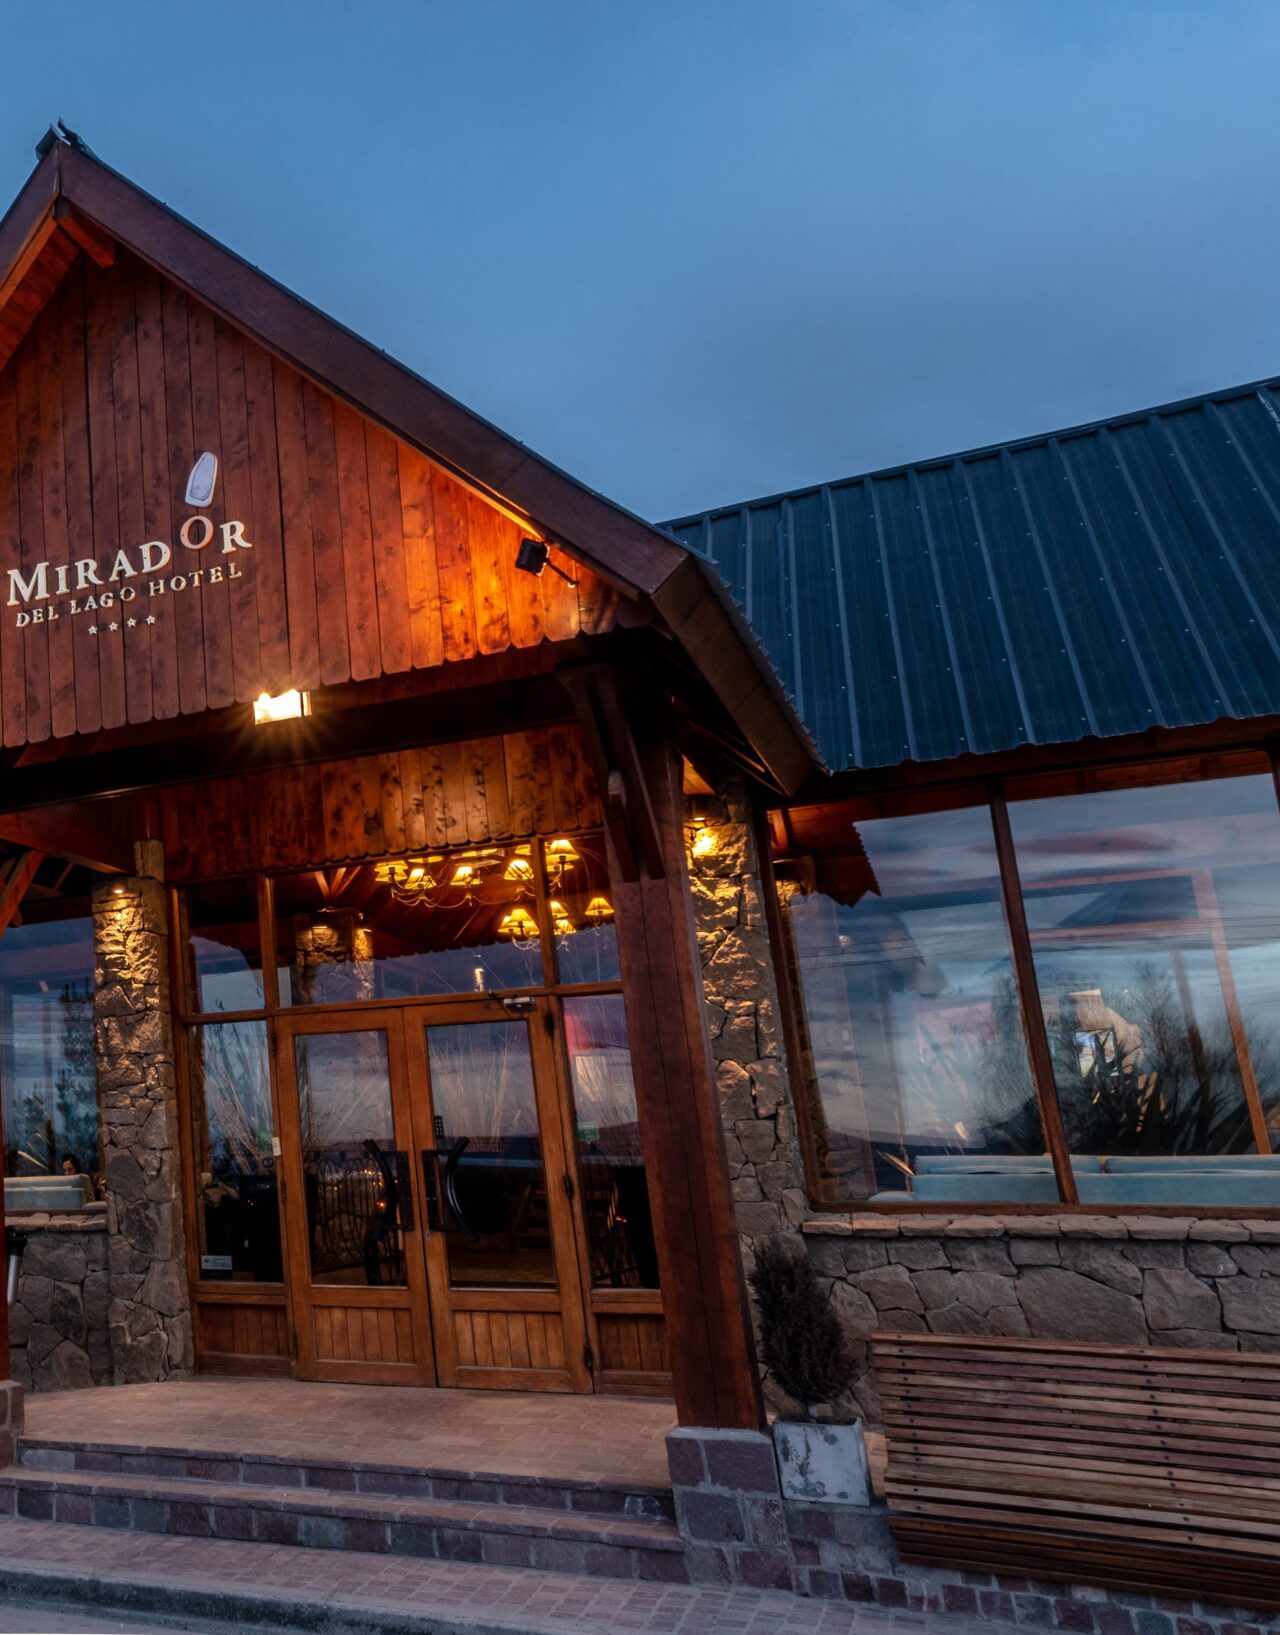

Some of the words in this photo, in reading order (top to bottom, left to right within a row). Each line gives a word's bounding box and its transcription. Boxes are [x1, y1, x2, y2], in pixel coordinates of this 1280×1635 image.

[7, 515, 253, 607] MIRADOR
[16, 605, 60, 627] DEL
[70, 586, 137, 614] LAGO
[149, 562, 243, 597] HOTEL
